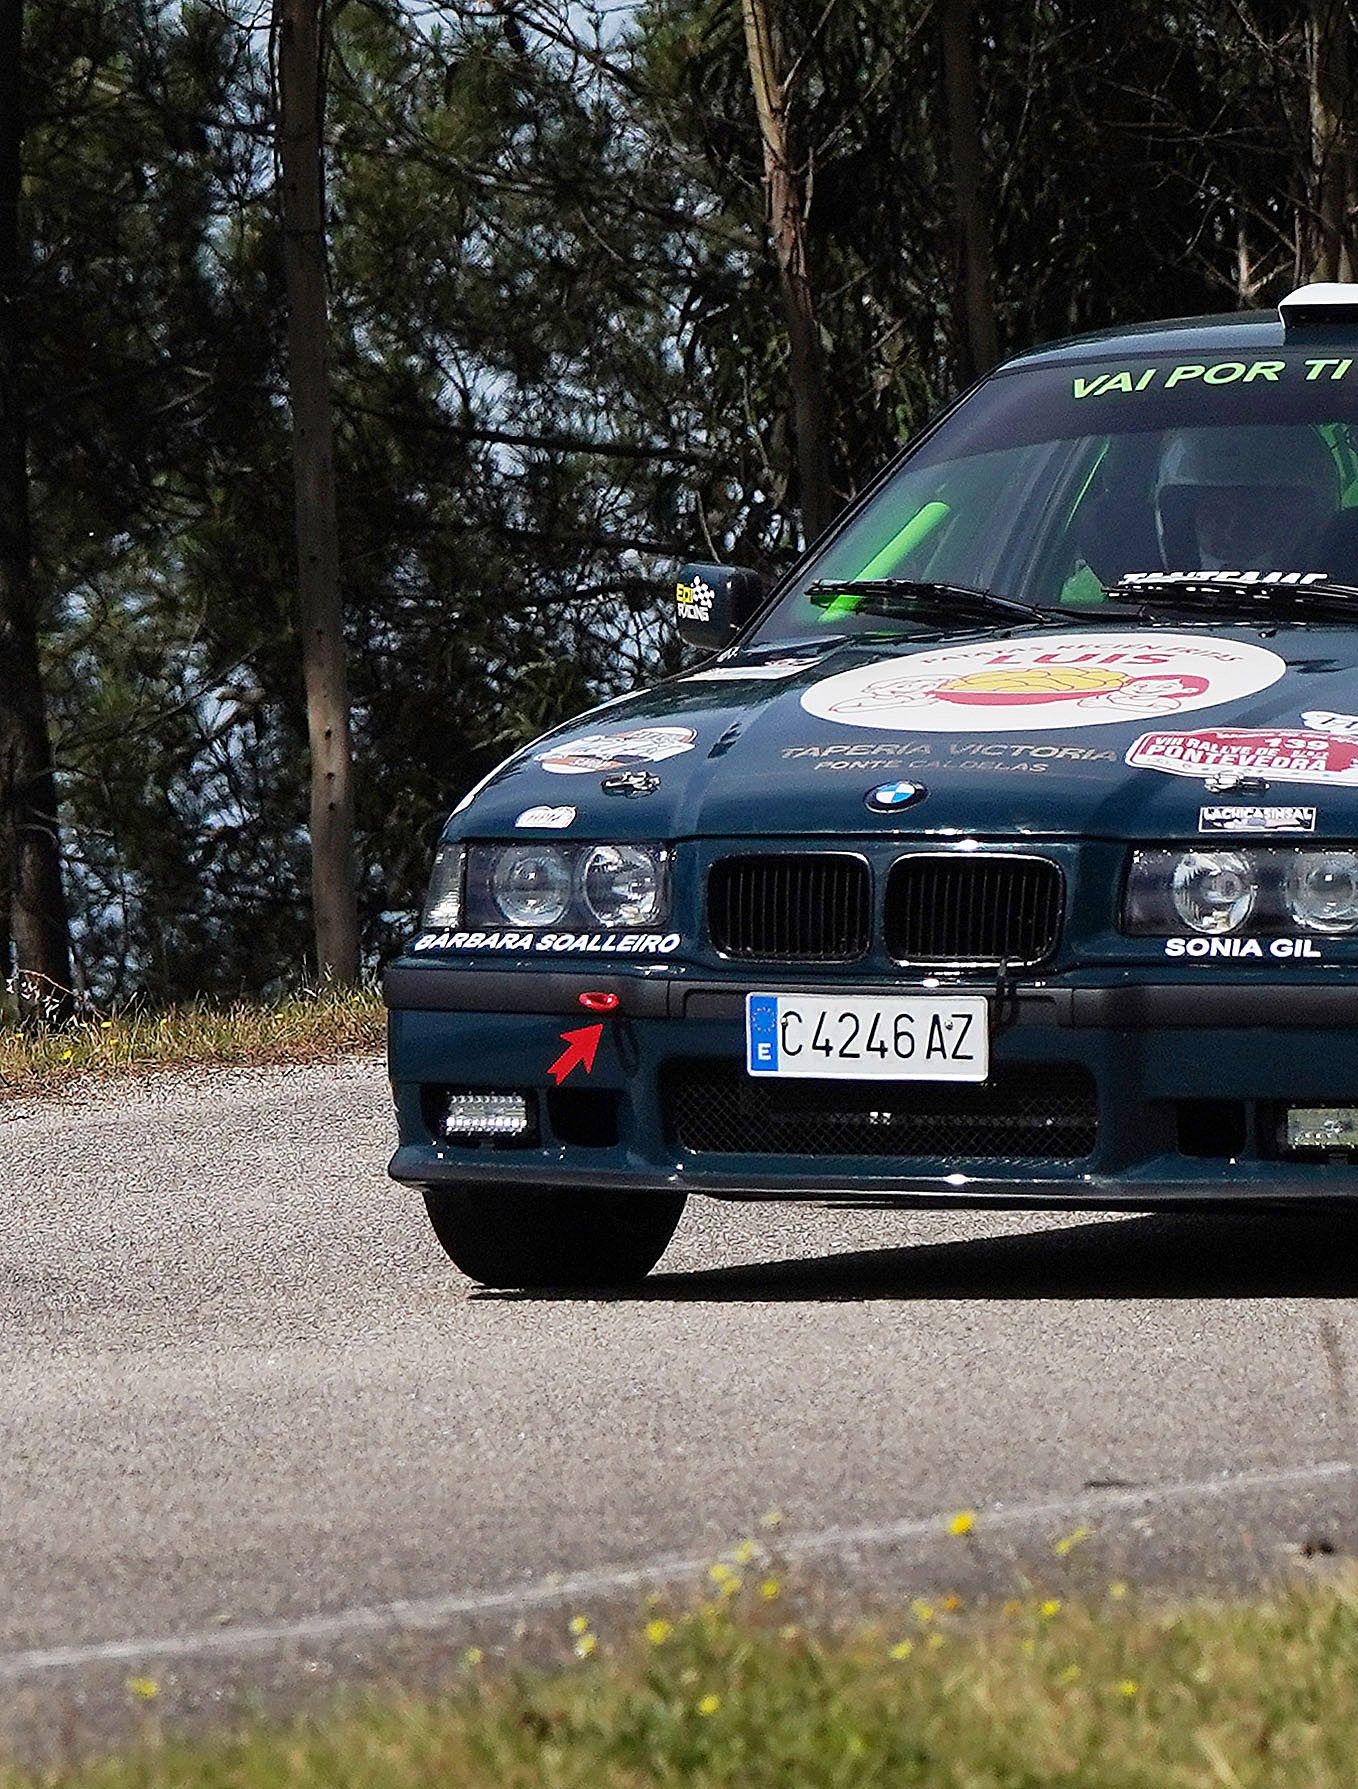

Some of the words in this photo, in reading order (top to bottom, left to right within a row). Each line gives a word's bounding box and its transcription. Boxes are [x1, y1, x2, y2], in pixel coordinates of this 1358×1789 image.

[1072, 366, 1156, 401] VAI
[1165, 359, 1284, 394] POR
[1304, 358, 1353, 382] TI
[677, 603, 710, 622] RACING
[984, 653, 1175, 665] LUIS
[949, 742, 1118, 763] VICTORIA
[1154, 736, 1184, 746] VIII
[1186, 738, 1251, 756] RALLYE
[1253, 746, 1281, 757] DE
[1264, 738, 1330, 751] 139
[814, 760, 902, 771] PONTE
[907, 760, 1049, 773] CALDELAS
[1148, 744, 1328, 772] PONTEVEDRA
[536, 933, 681, 953] SOALLEIRO
[1164, 937, 1263, 958] SONIA
[1269, 938, 1321, 958] GIL
[757, 1043, 772, 1060] E
